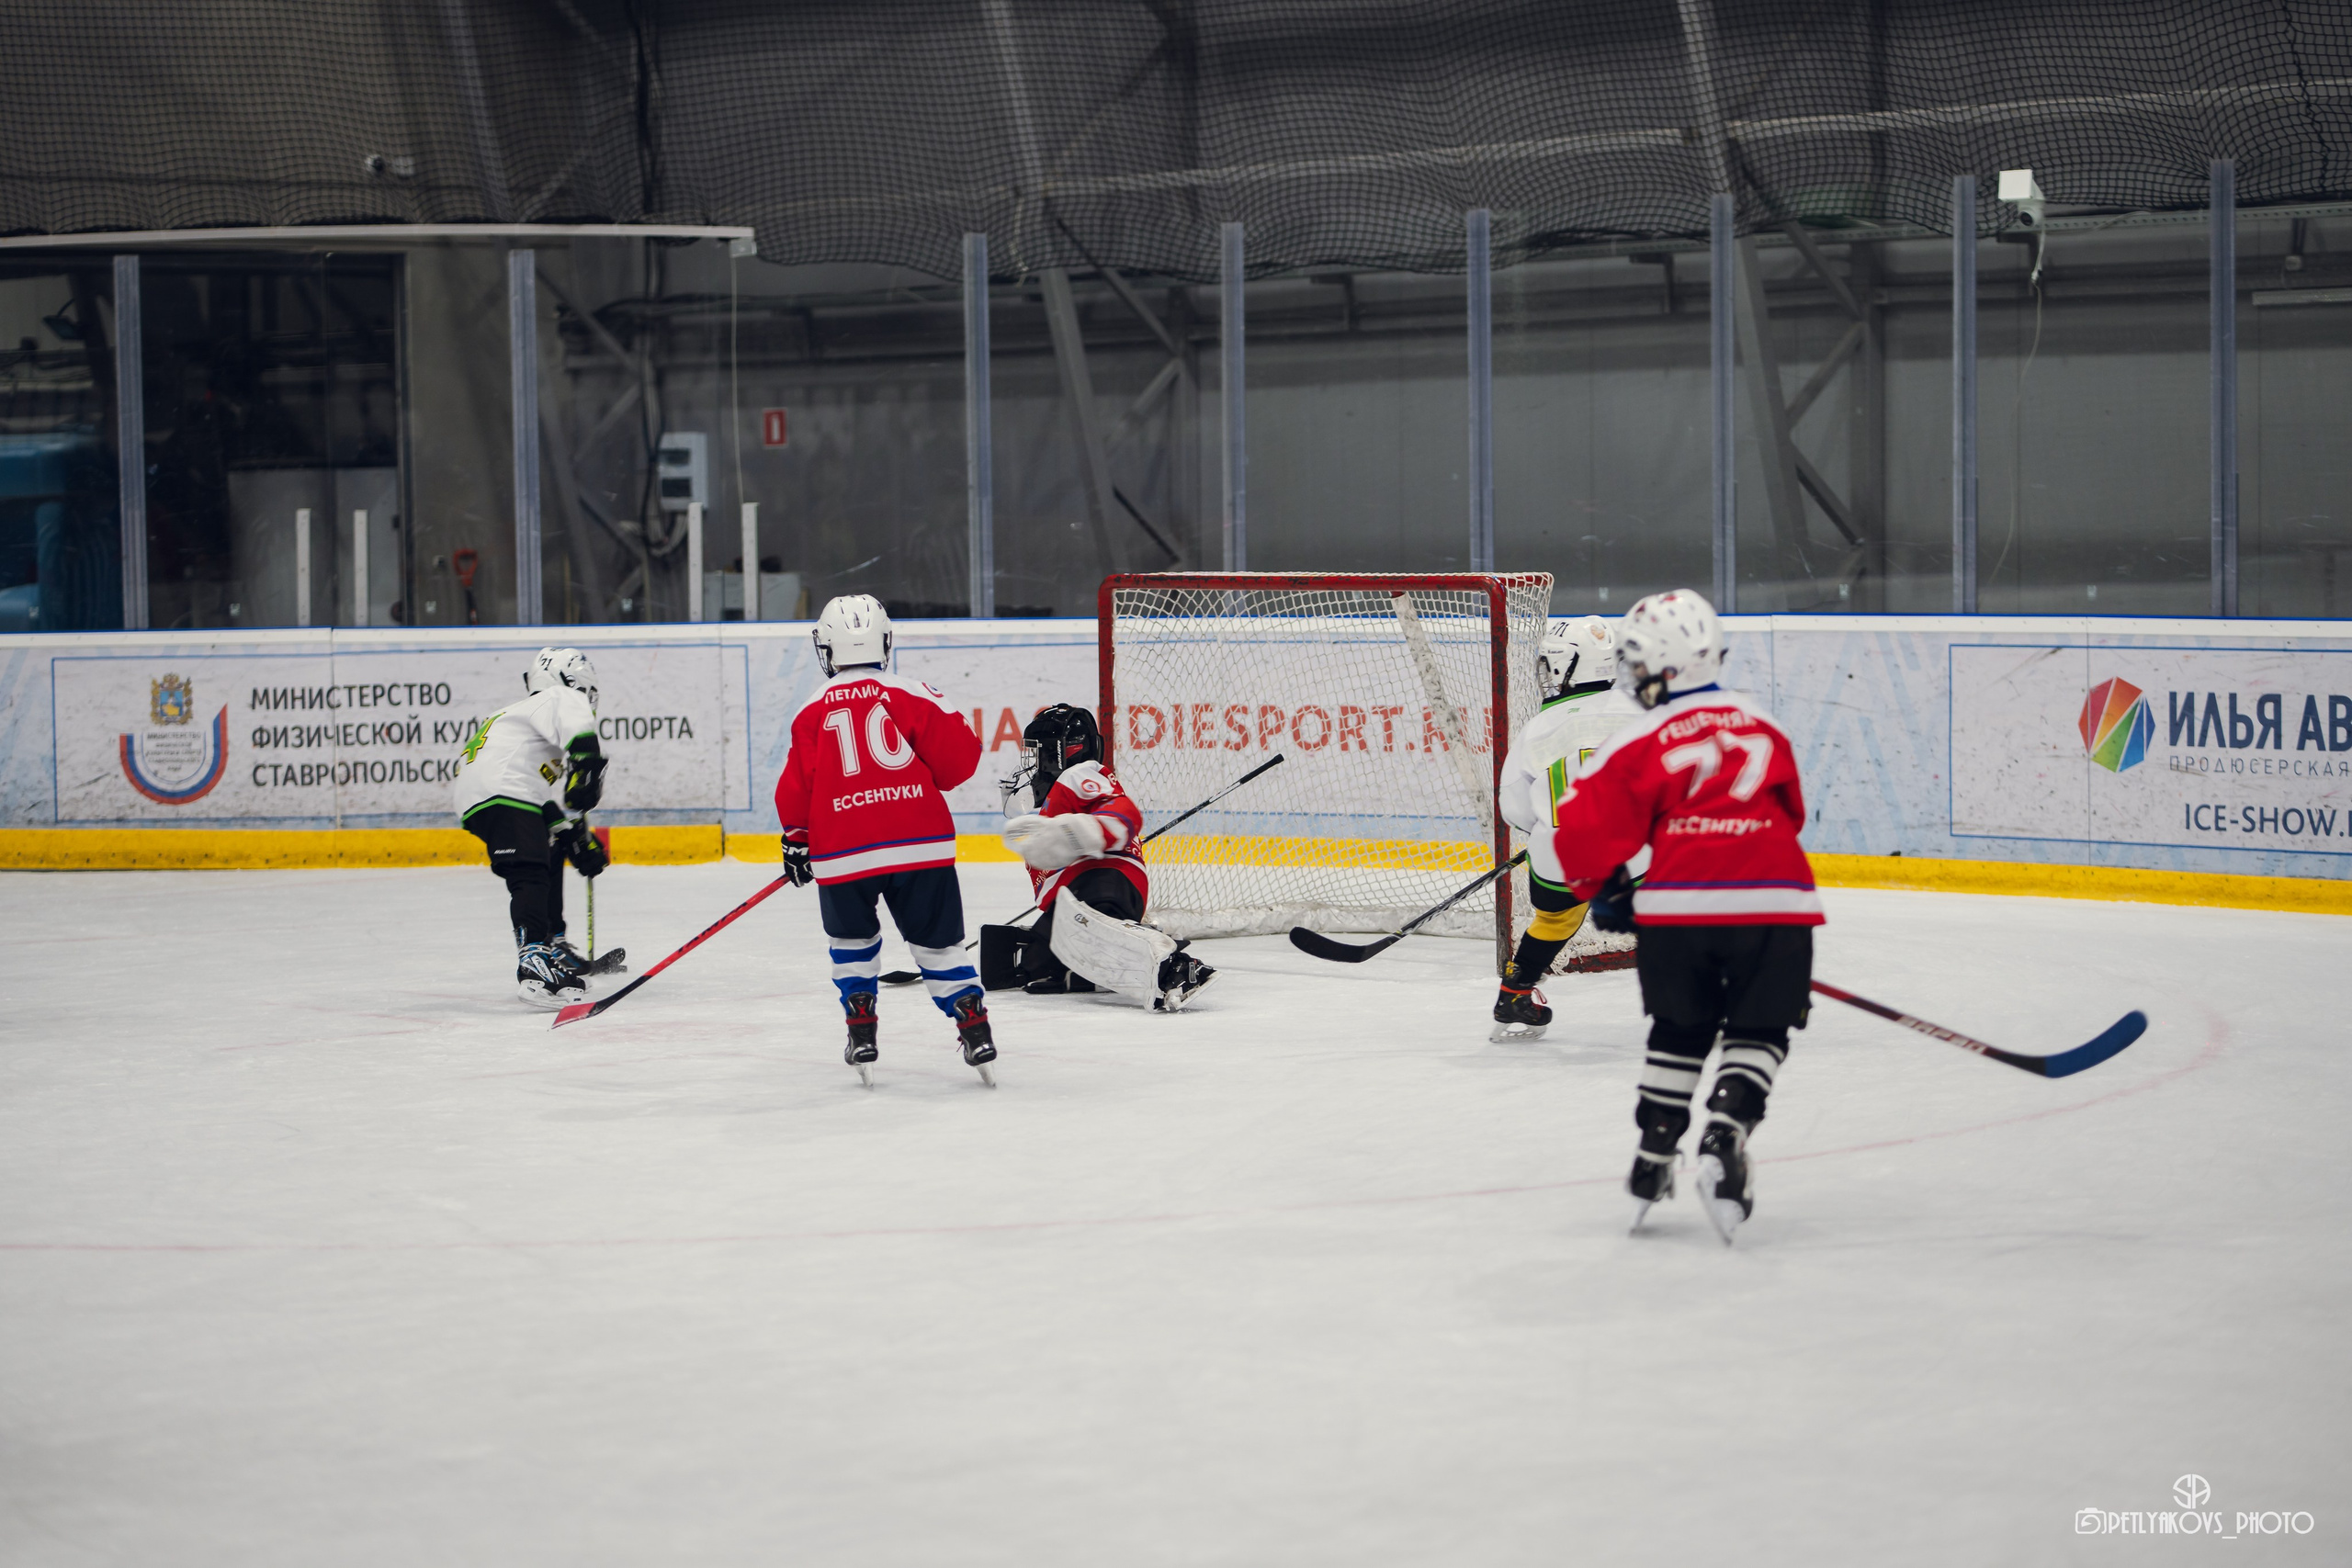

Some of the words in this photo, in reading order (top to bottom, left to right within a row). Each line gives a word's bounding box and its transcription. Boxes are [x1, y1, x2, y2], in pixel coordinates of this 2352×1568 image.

[251, 682, 452, 710] МИНИСТЕРСТВО
[251, 714, 422, 749] ФИЗИЧЕСКОЙ
[599, 716, 694, 741] СПОРТА
[2168, 691, 2282, 750] ИЛЬЯ
[2296, 694, 2352, 752] АВ
[823, 707, 916, 777] 10
[1660, 729, 1775, 802] 77
[2169, 755, 2349, 778] ПРОДЮСЕРСКАЯ
[832, 784, 923, 812] ЕССЕНТУКИ
[2184, 803, 2352, 838] ICE-SHOW.
